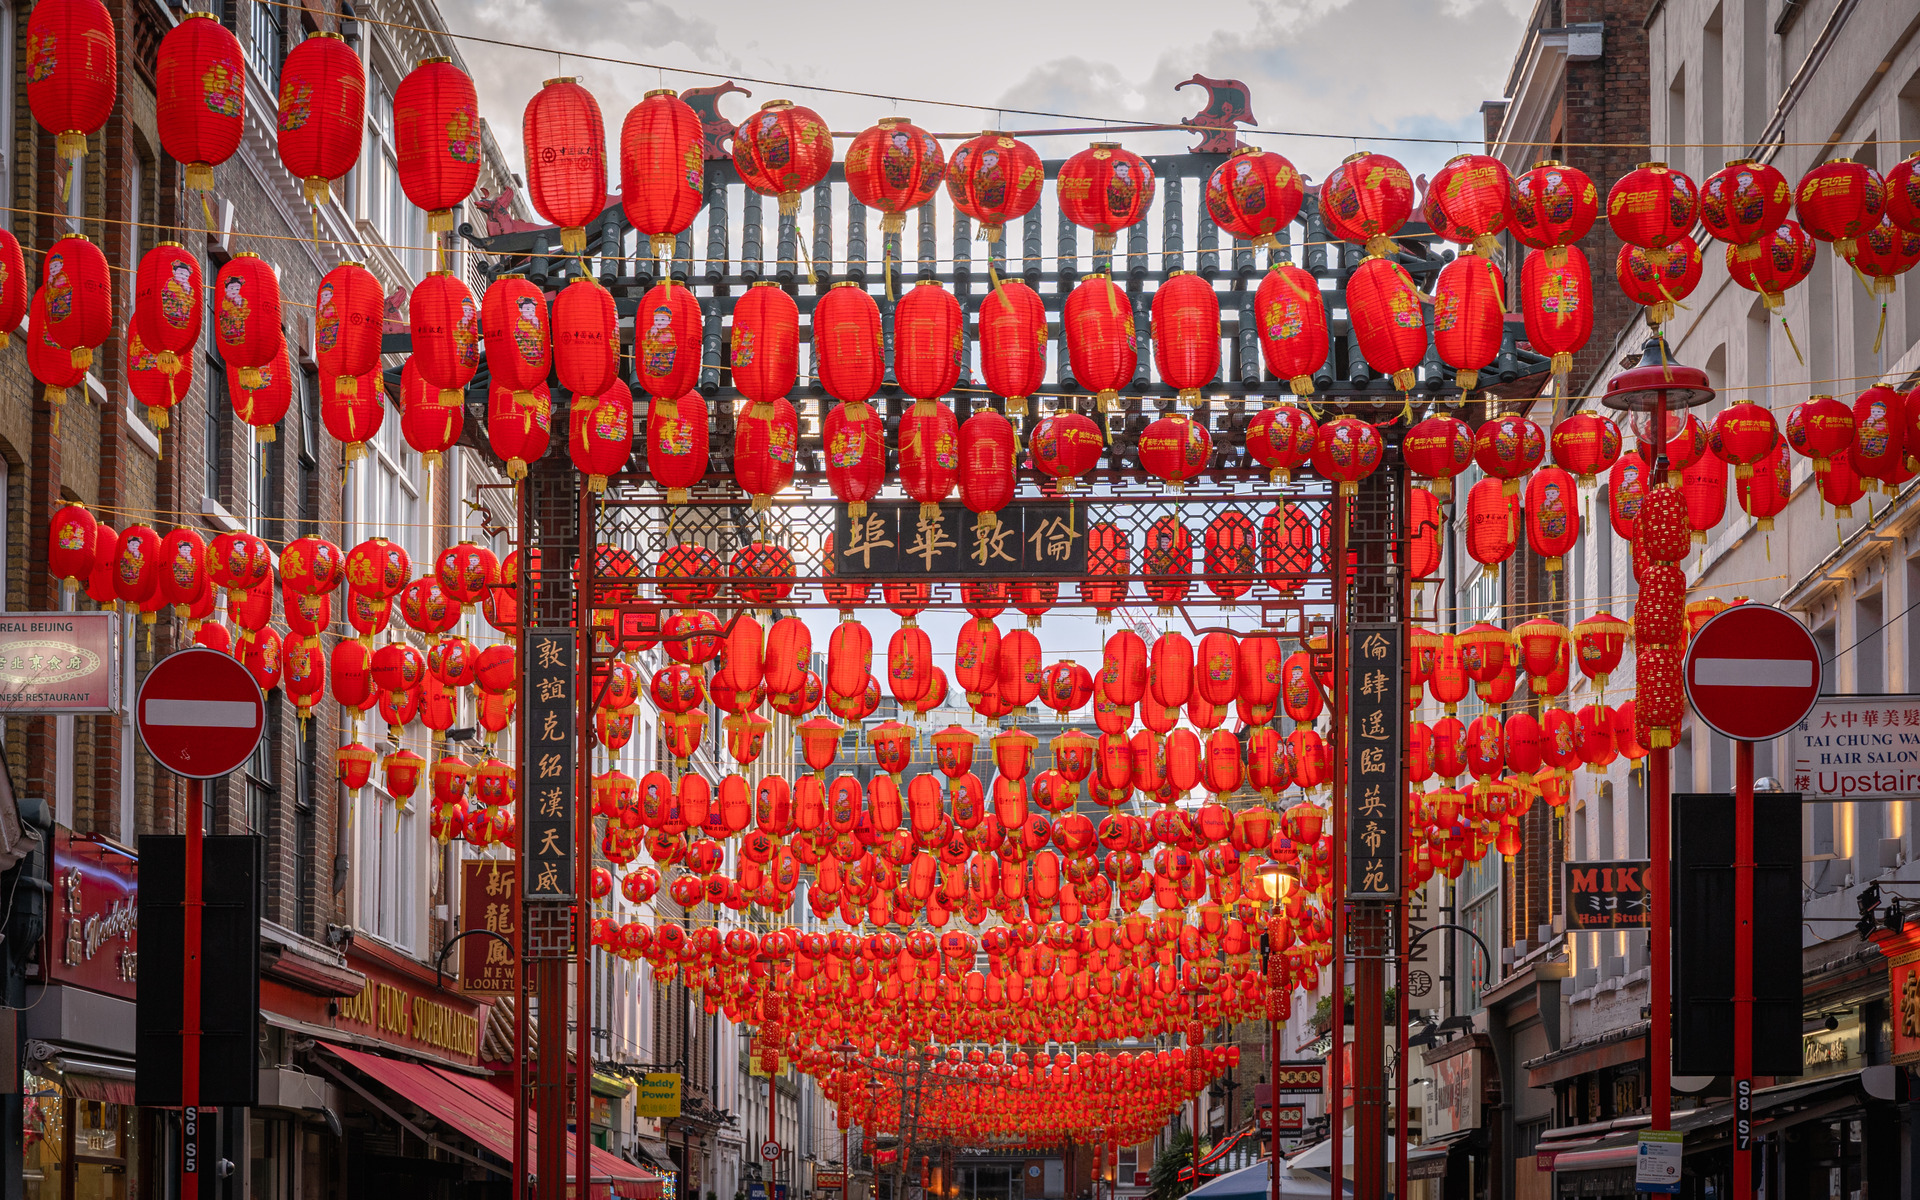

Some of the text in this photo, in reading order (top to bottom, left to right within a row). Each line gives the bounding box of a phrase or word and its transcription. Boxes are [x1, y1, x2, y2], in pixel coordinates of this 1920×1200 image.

[1466, 166, 1497, 182] SUNS
[1819, 175, 1853, 189] SUNS
[1626, 190, 1659, 204] SUNS
[0, 622, 73, 632] REAL BEIJING
[26, 692, 90, 702] RESTAURANT
[1820, 709, 1920, 729] 大中華美髮
[1804, 735, 1830, 747] TAI
[1836, 734, 1893, 747] CHUNG
[1821, 751, 1918, 764] HAIR SALON
[1818, 769, 1920, 797] Upstair
[1578, 913, 1610, 924] Hair
[483, 967, 515, 978] NEW
[465, 979, 499, 989] LOON
[378, 982, 408, 1035] FUNG
[412, 996, 478, 1057] SUPERMARKET
[641, 1079, 675, 1089] Paddy
[641, 1091, 675, 1099] Power
[764, 1146, 779, 1156] 20
